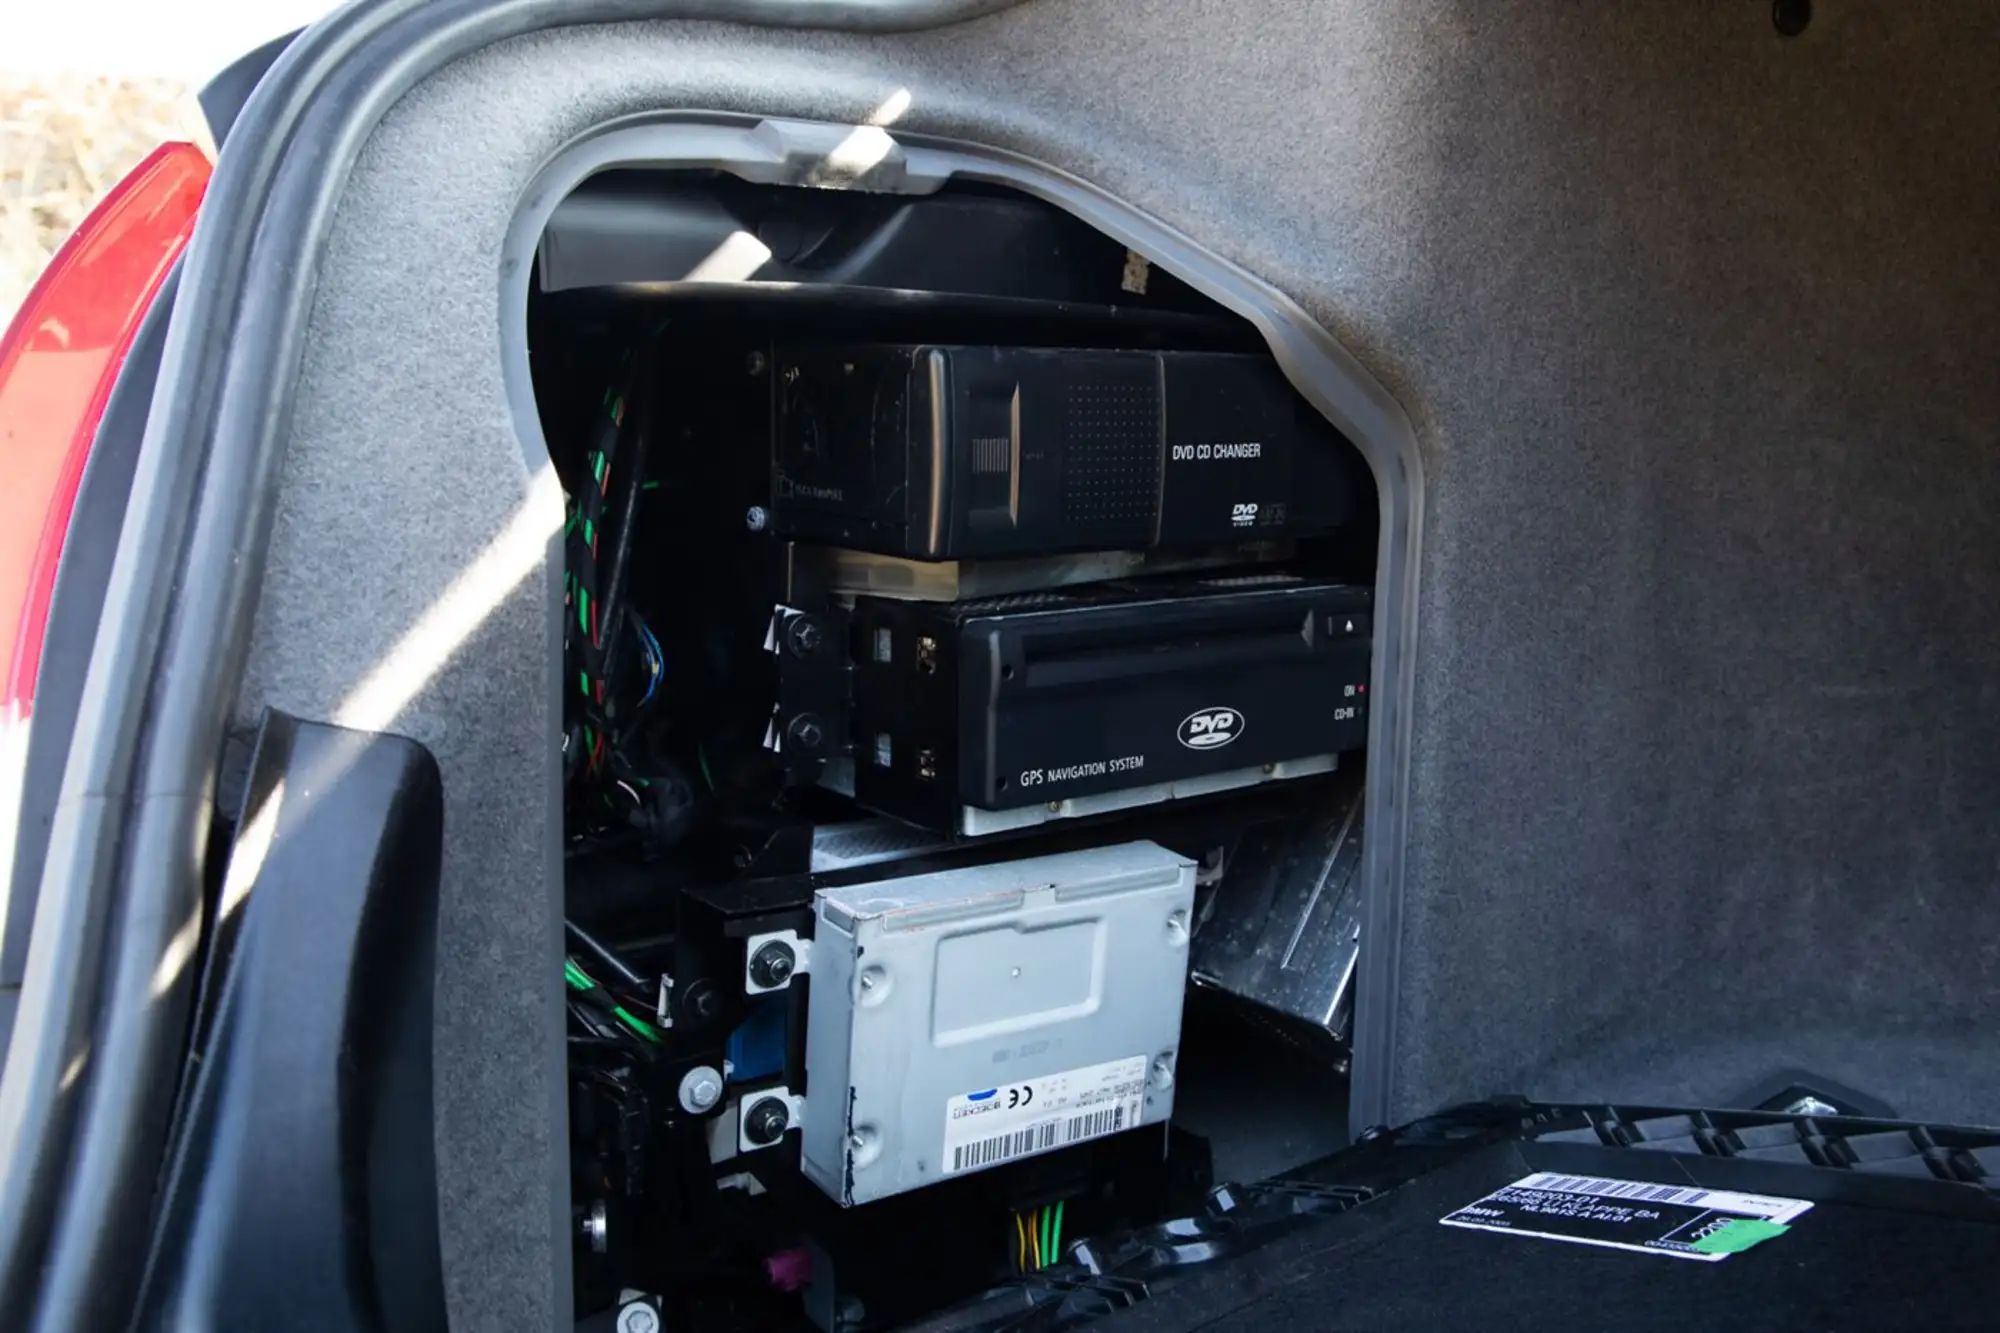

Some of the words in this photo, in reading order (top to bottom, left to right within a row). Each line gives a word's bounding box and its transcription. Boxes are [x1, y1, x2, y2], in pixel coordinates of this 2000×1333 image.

[1172, 445, 1193, 460] DVD
[1196, 444, 1211, 460] CD
[1213, 443, 1261, 459] CHANGER
[1232, 503, 1258, 515] DVD
[1189, 712, 1234, 734] DVD
[1020, 769, 1043, 787] GPS
[1047, 761, 1106, 782] NAVIGATION
[1109, 754, 1145, 773] SYSTEM
